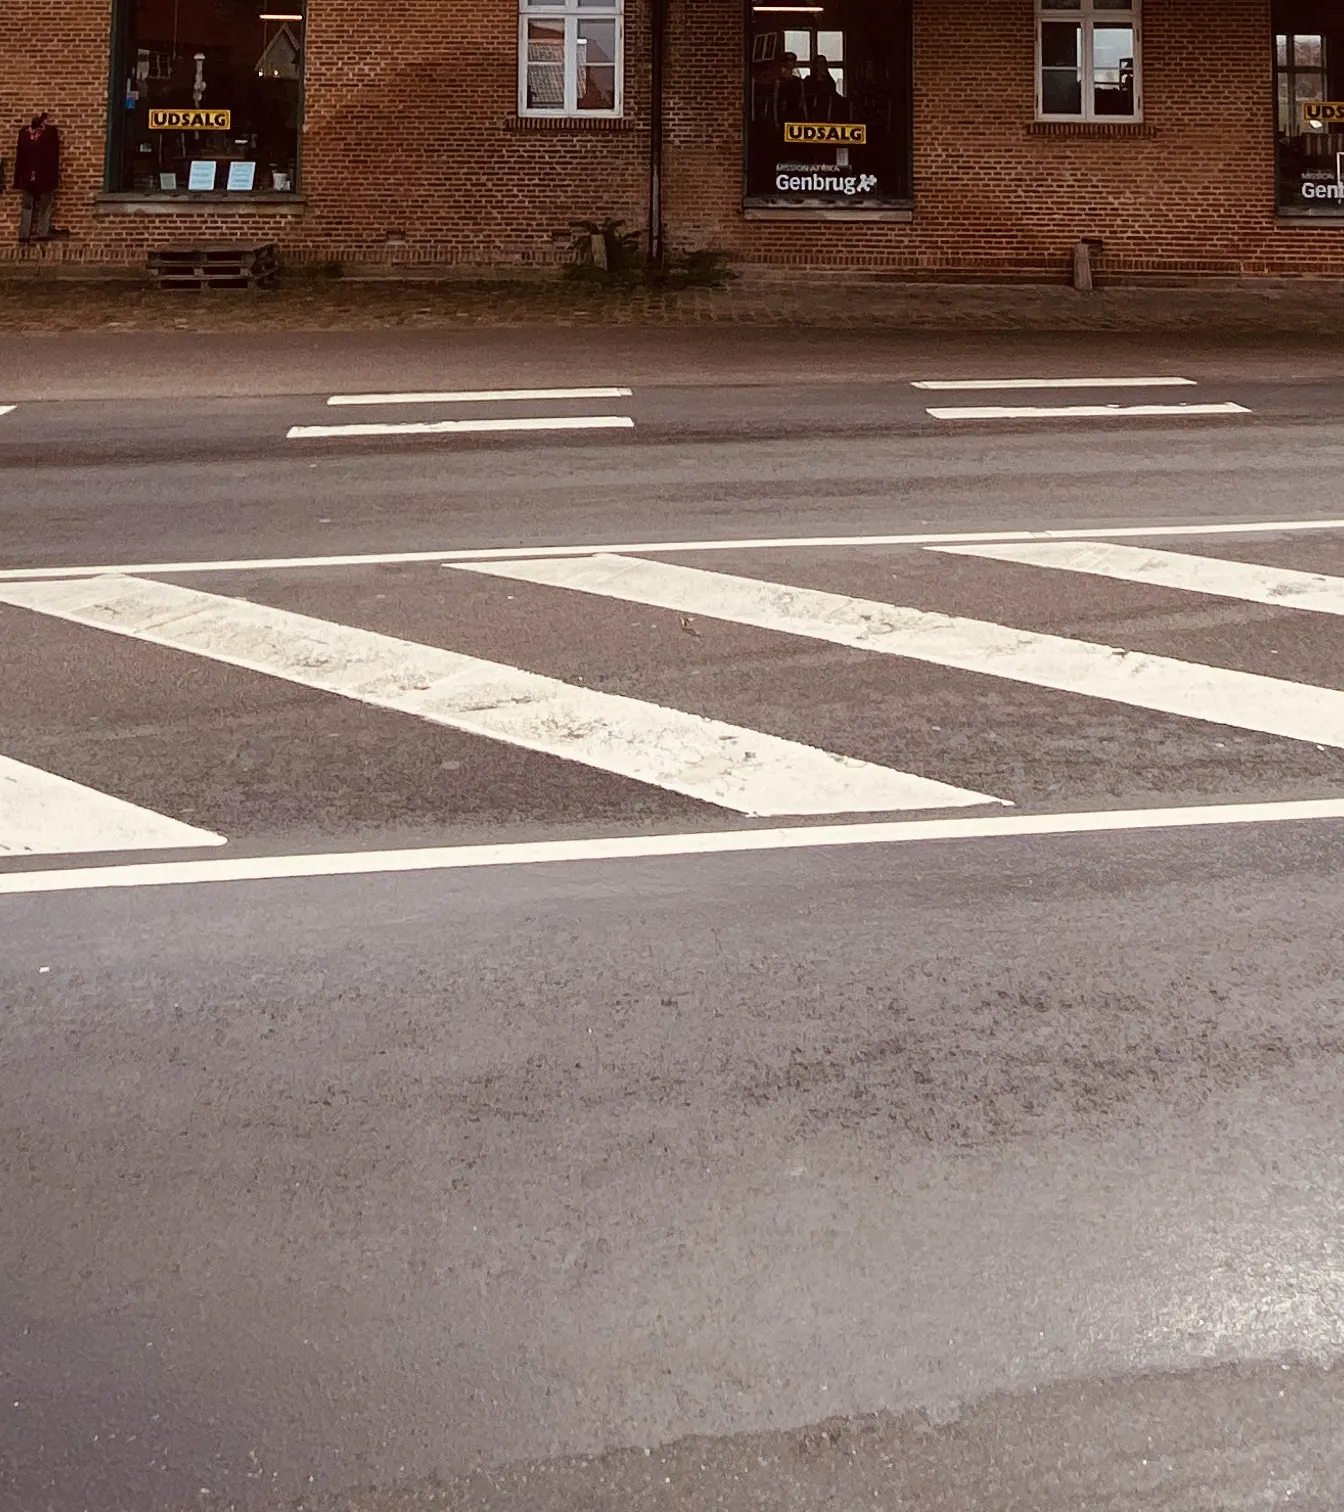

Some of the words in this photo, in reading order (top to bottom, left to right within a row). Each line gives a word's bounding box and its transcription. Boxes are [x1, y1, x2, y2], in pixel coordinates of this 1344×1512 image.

[154, 112, 226, 127] UDSALG
[789, 125, 862, 141] UDSALG
[776, 173, 857, 195] Genbrug
